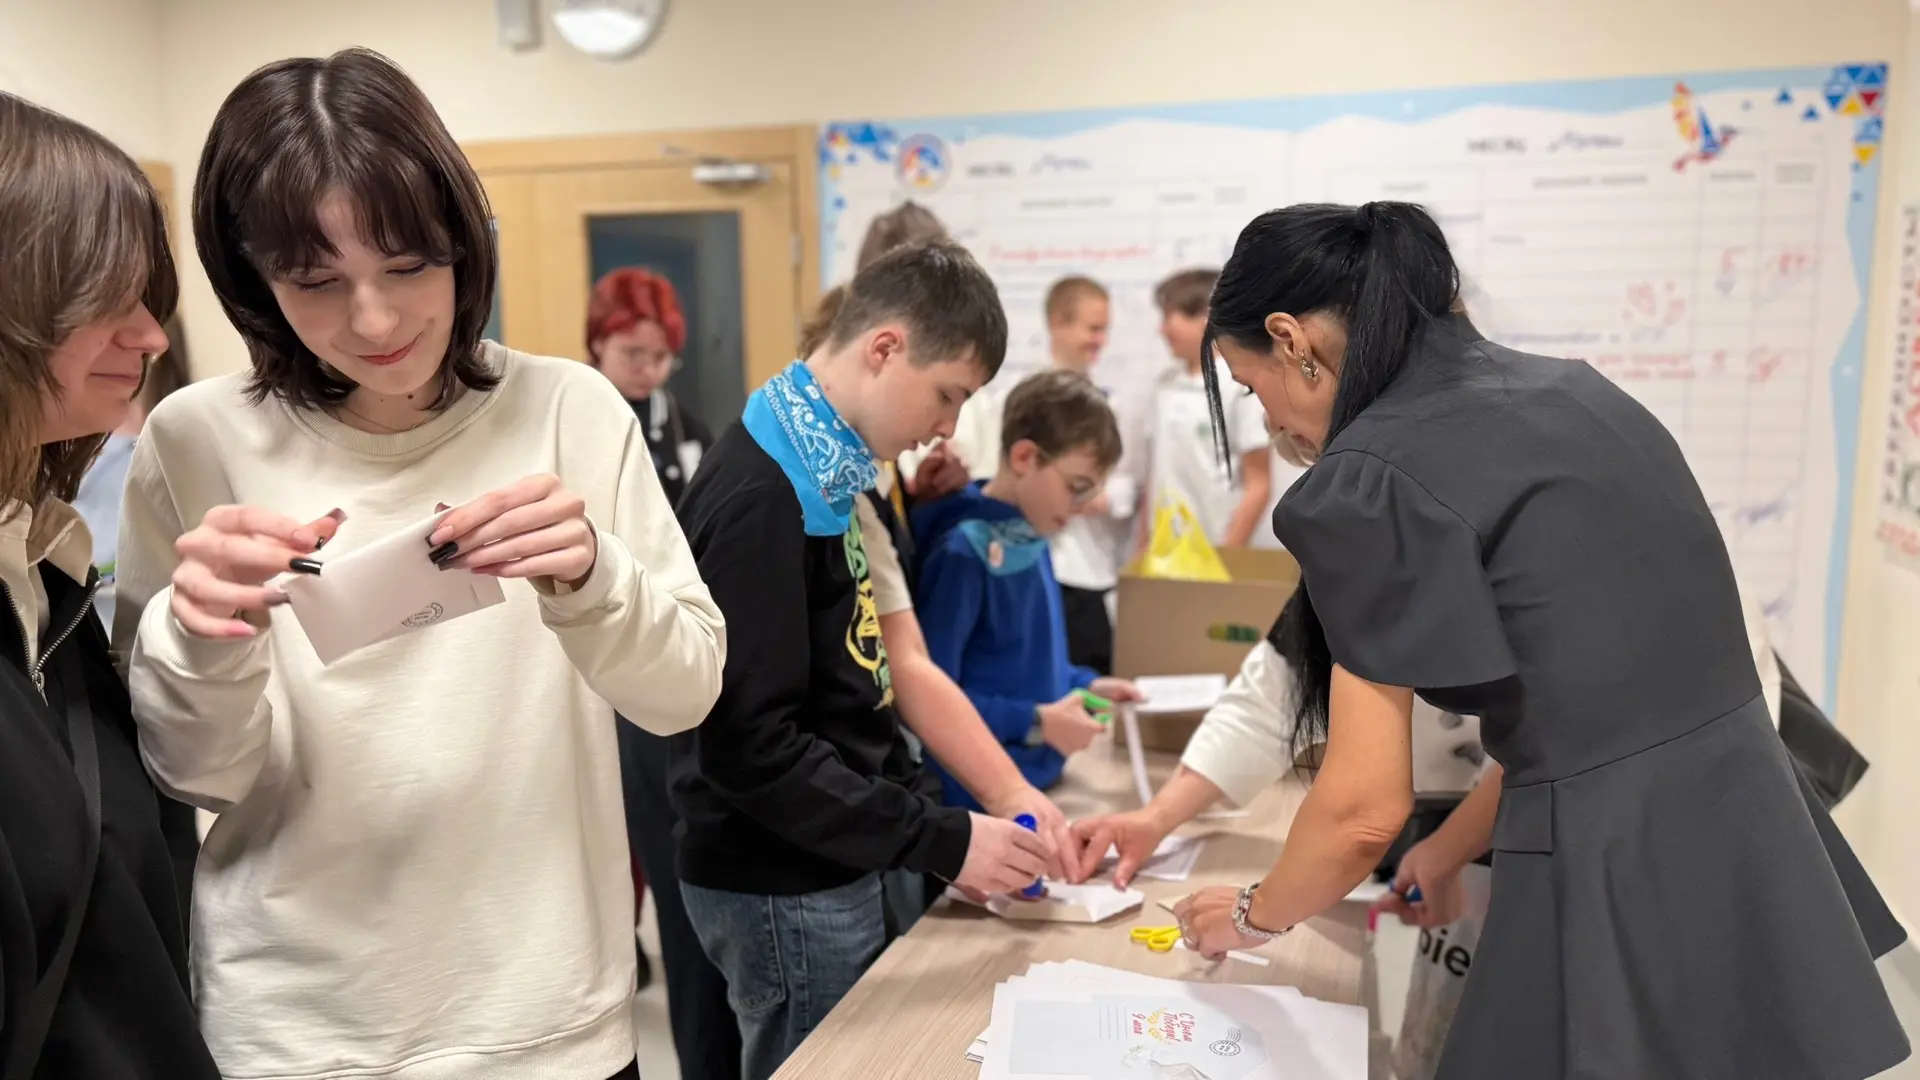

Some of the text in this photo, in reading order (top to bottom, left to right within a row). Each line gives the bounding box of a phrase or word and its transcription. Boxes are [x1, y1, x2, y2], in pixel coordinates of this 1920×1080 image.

[1133, 1019, 1143, 1035] мая
[1160, 1012, 1181, 1042] Победы!
[1179, 1012, 1195, 1042] С Днем
